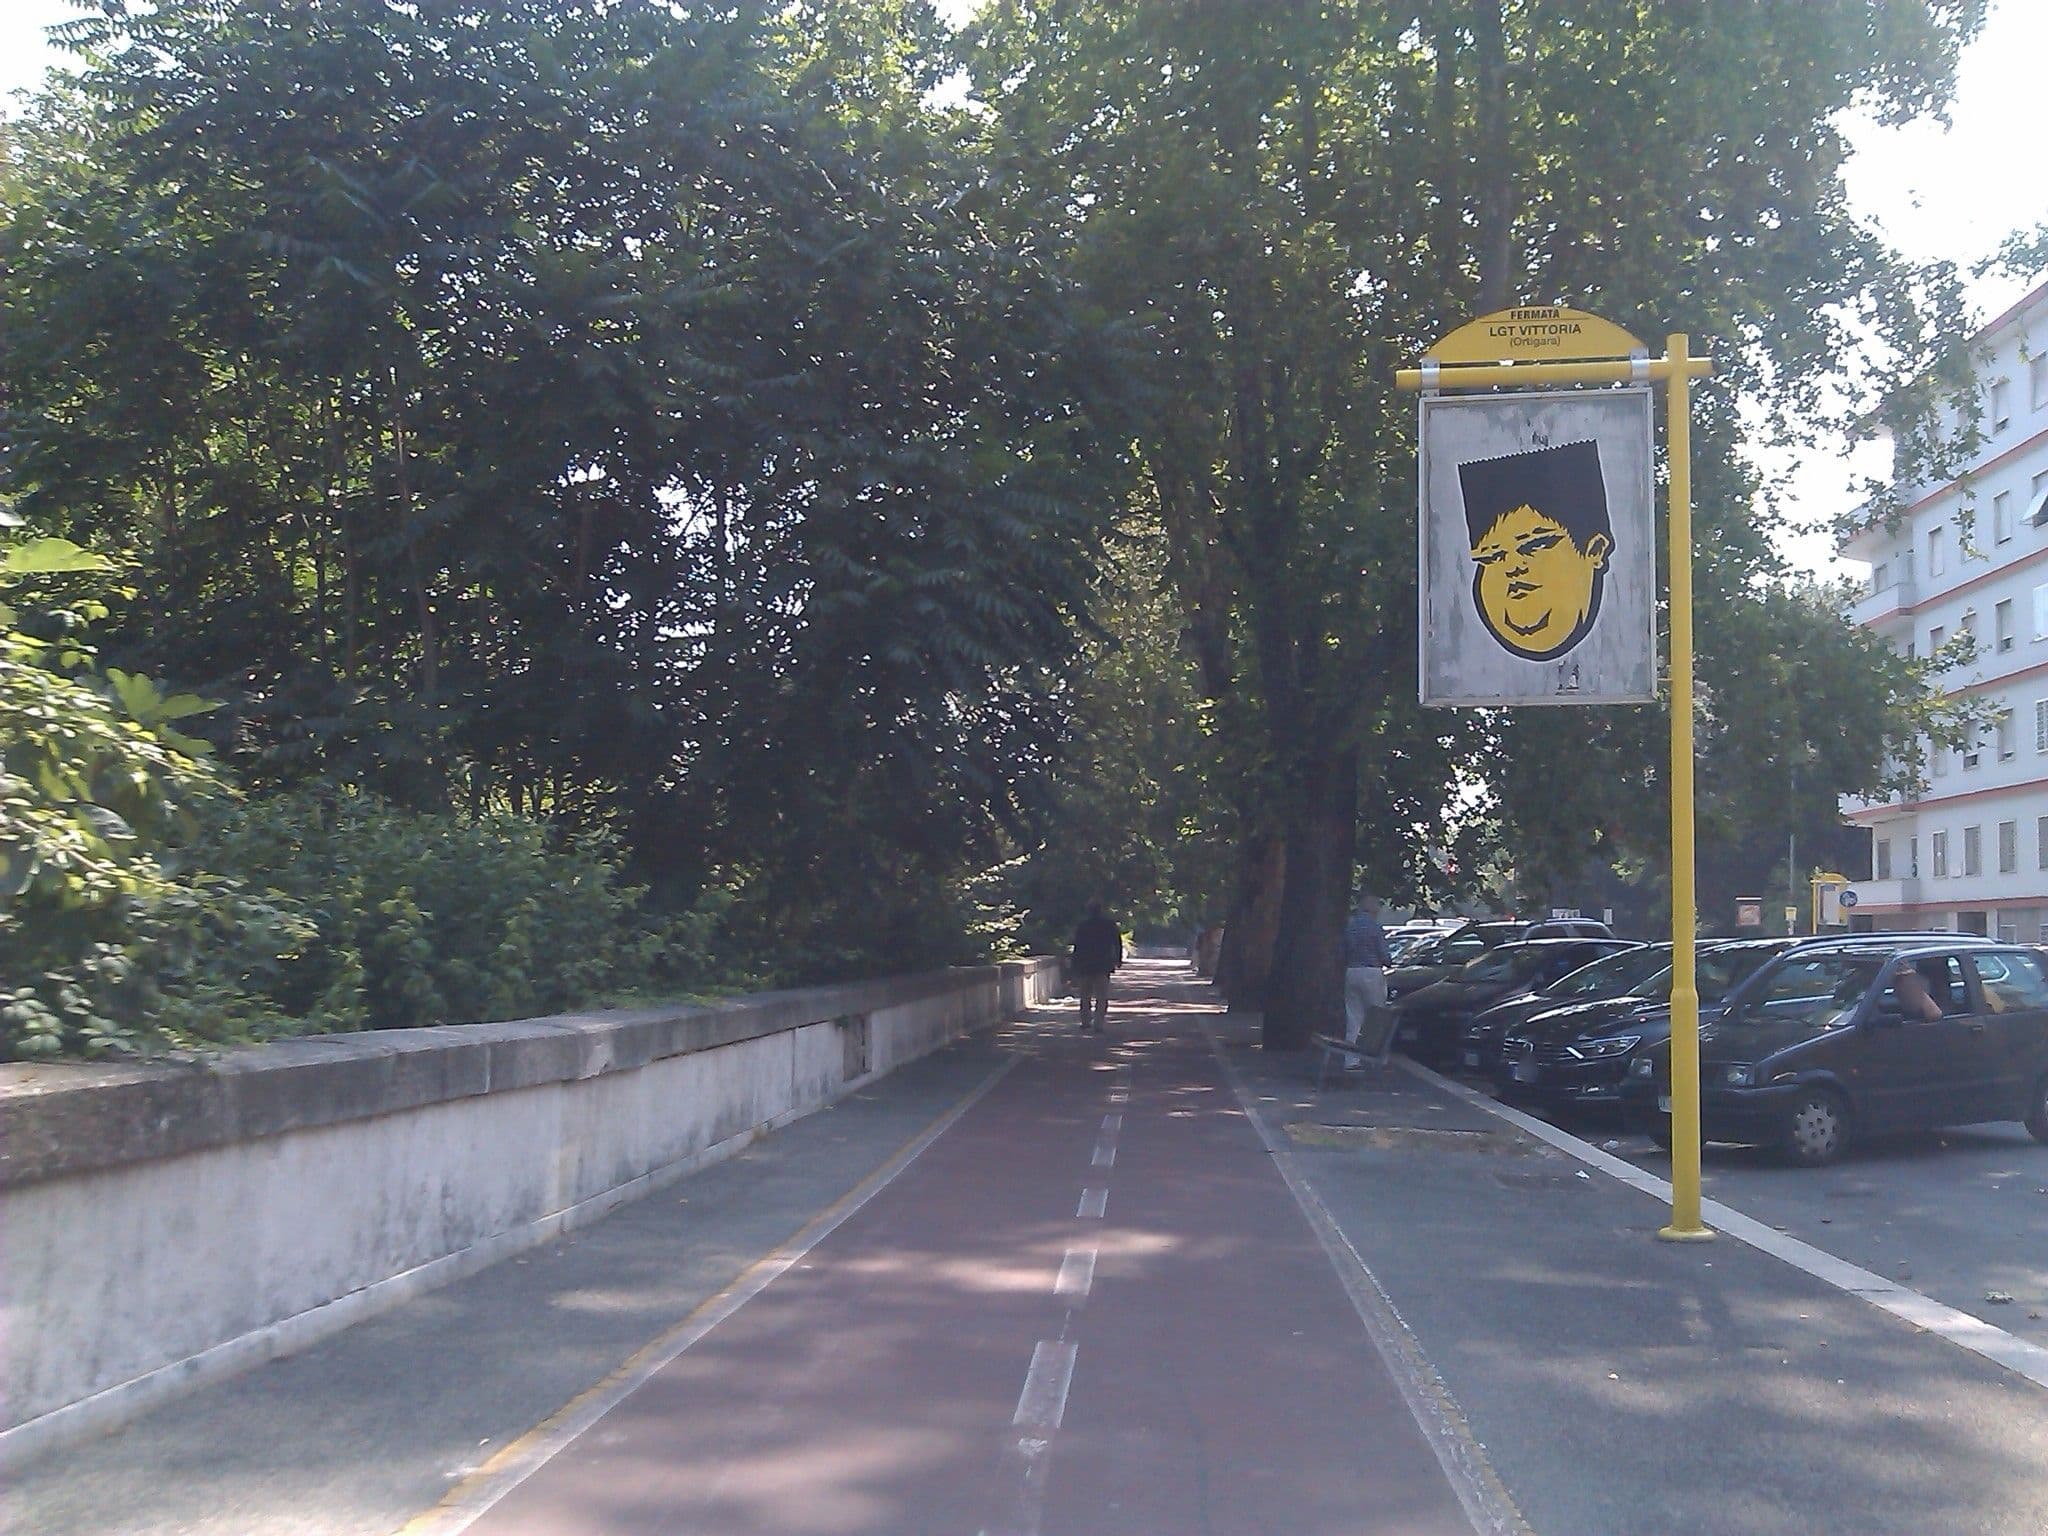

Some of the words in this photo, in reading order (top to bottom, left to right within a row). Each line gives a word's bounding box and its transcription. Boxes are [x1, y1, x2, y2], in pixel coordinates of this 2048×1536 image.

[1511, 309, 1560, 319] FERMATA
[1489, 325, 1516, 337] LGT
[1519, 323, 1582, 336] VITTORIA
[1510, 336, 1561, 348] (Ortigara)
